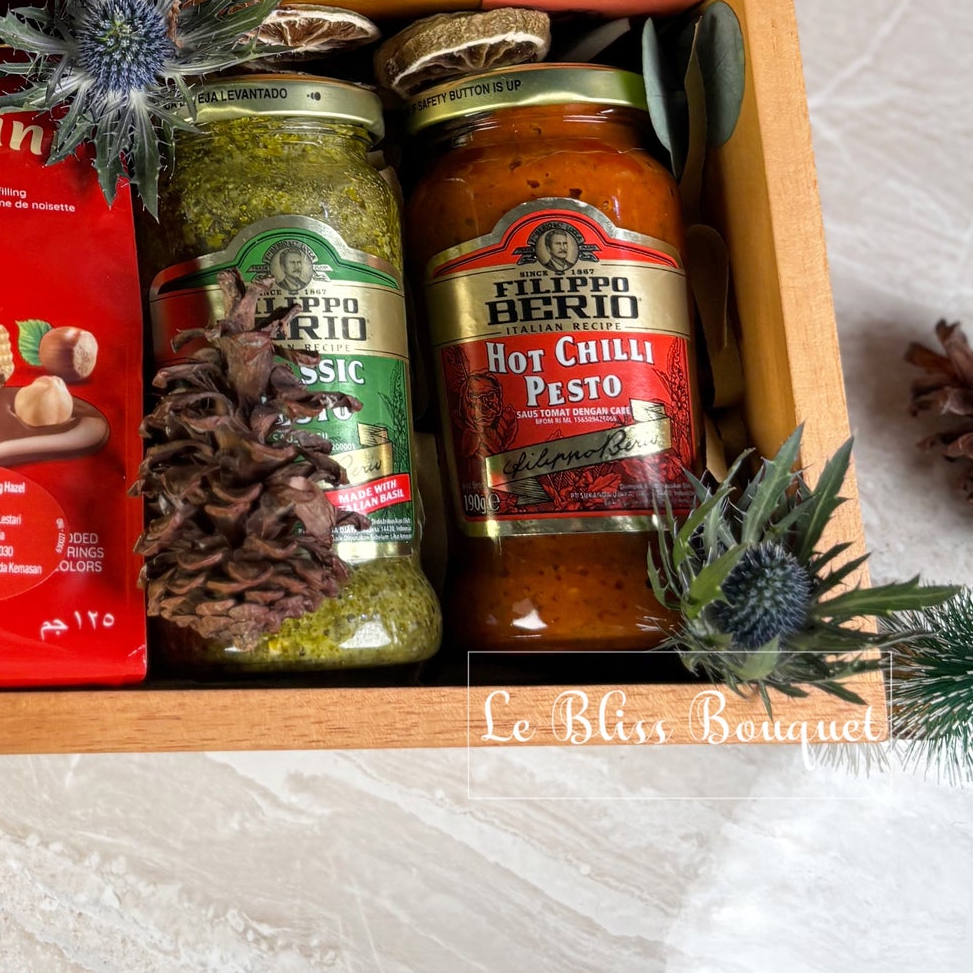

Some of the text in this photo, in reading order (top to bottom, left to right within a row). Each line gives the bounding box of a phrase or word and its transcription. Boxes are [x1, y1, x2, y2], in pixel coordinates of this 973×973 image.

[221, 87, 287, 102] LEVANTADO
[418, 79, 521, 111] SAFETY BUTTON IS UP
[15, 198, 28, 209] de
[31, 201, 75, 213] noisette
[494, 274, 629, 299] FILIPPO
[485, 296, 638, 325] BERIO
[505, 320, 623, 335] ITALIAN RECIPE
[486, 336, 654, 377] HOT CHILLI
[299, 358, 365, 385] SSIC
[525, 374, 622, 408] PESTO
[516, 407, 609, 419] SAUS TOMAT DENGAN
[4, 481, 25, 494] Hazel
[338, 479, 397, 503] MADE WITH
[380, 488, 404, 504] BASIL
[464, 495, 486, 514] 190g
[8, 562, 42, 575] Kemasan
[40, 610, 115, 641] ١٢٥ جم
